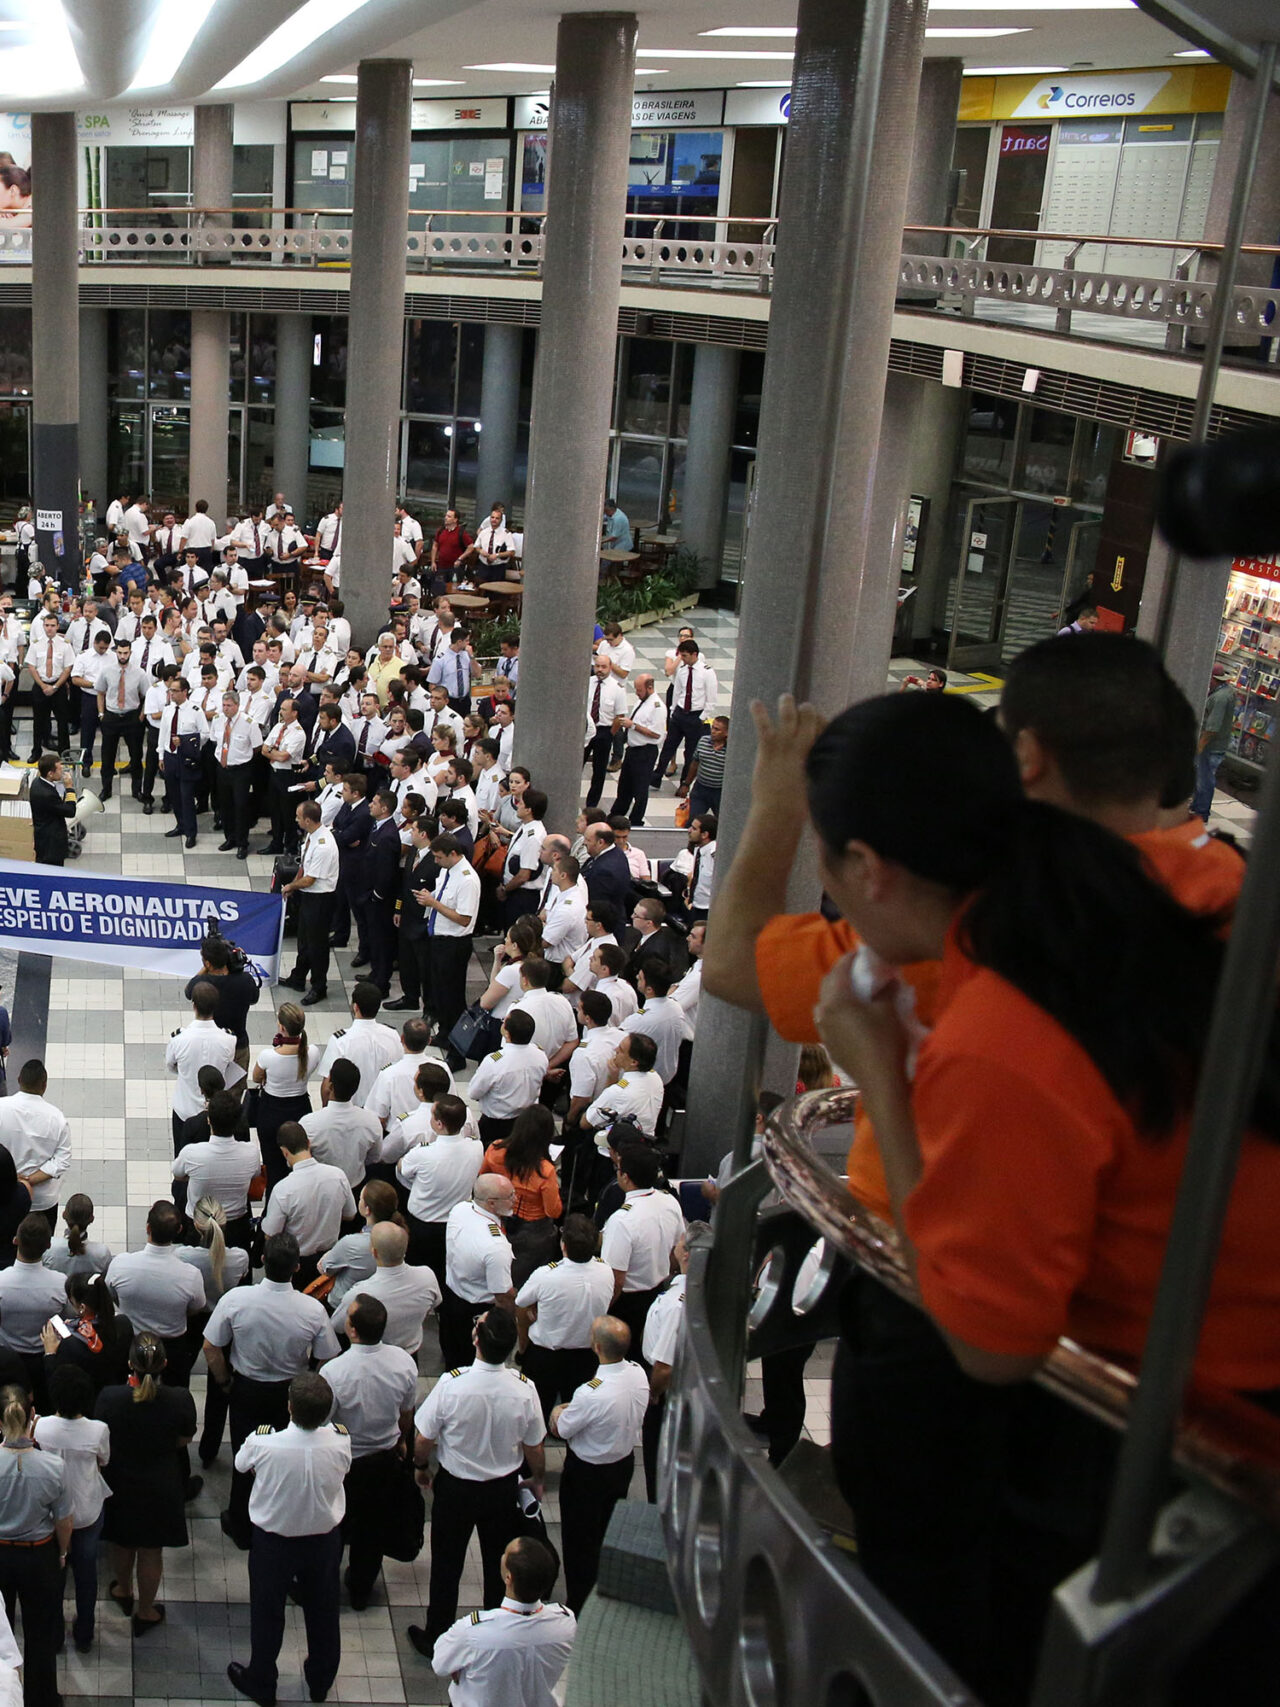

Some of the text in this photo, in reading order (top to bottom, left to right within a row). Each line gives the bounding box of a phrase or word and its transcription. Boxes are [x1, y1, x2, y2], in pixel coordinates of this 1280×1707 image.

[640, 100, 696, 110] BRASILEIRA
[1065, 92, 1136, 108] Correios
[84, 115, 111, 129] SPA
[529, 115, 549, 126] ABA
[642, 113, 656, 121] DE
[656, 111, 697, 121] VIAGENS
[1232, 557, 1280, 577] OKSTO
[48, 890, 240, 922] AERONAUTAS
[81, 916, 93, 935] E
